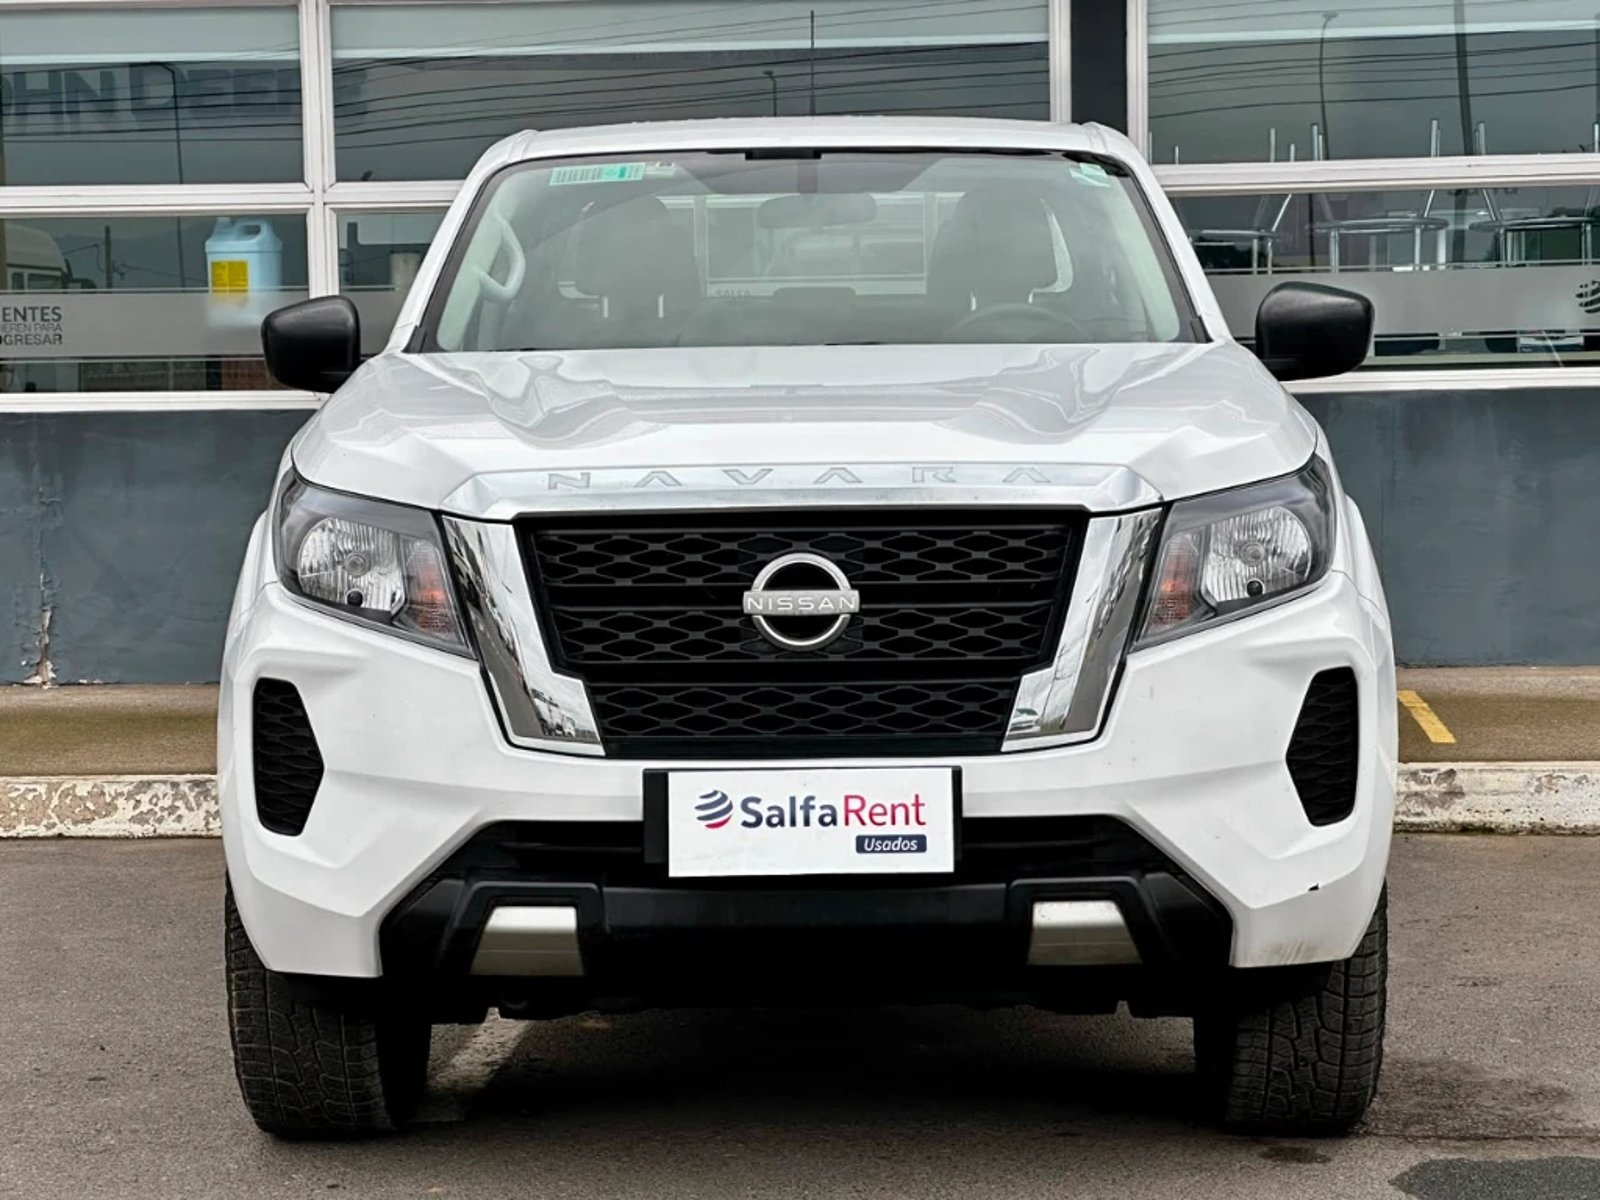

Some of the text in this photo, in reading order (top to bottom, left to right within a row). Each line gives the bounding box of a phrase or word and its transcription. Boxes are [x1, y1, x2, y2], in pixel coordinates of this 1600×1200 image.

[34, 322, 63, 333] PARA
[0, 334, 63, 345] GRESAR
[548, 467, 1050, 490] NAVARA
[747, 596, 855, 611] NISSAN
[863, 837, 918, 852] Usados
